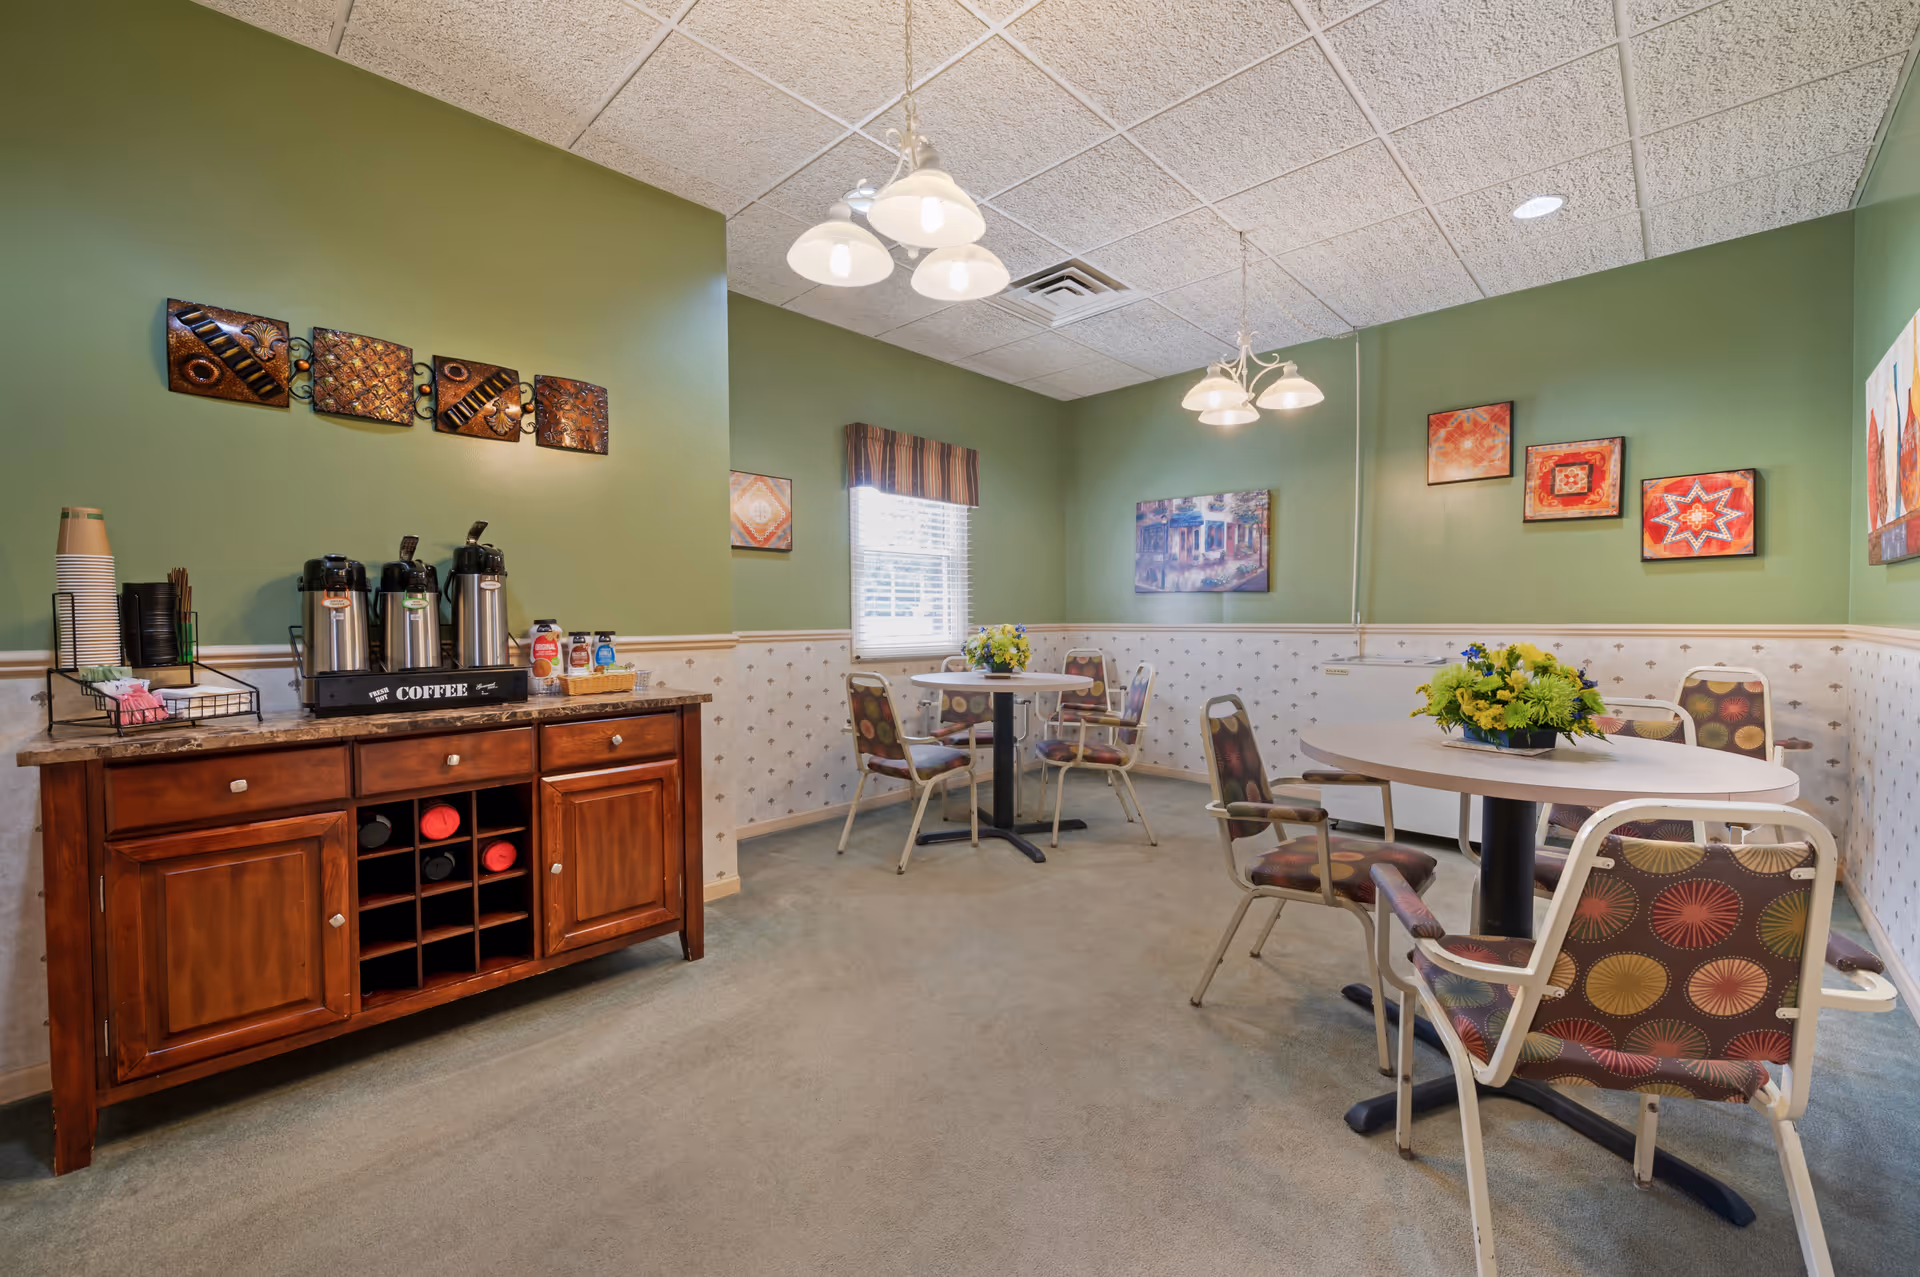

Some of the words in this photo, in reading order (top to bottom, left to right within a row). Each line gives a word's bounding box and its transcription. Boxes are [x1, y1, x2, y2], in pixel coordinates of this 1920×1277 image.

[368, 687, 390, 698] FRESH
[395, 683, 468, 701] COFFEE
[374, 694, 389, 703] HOT
